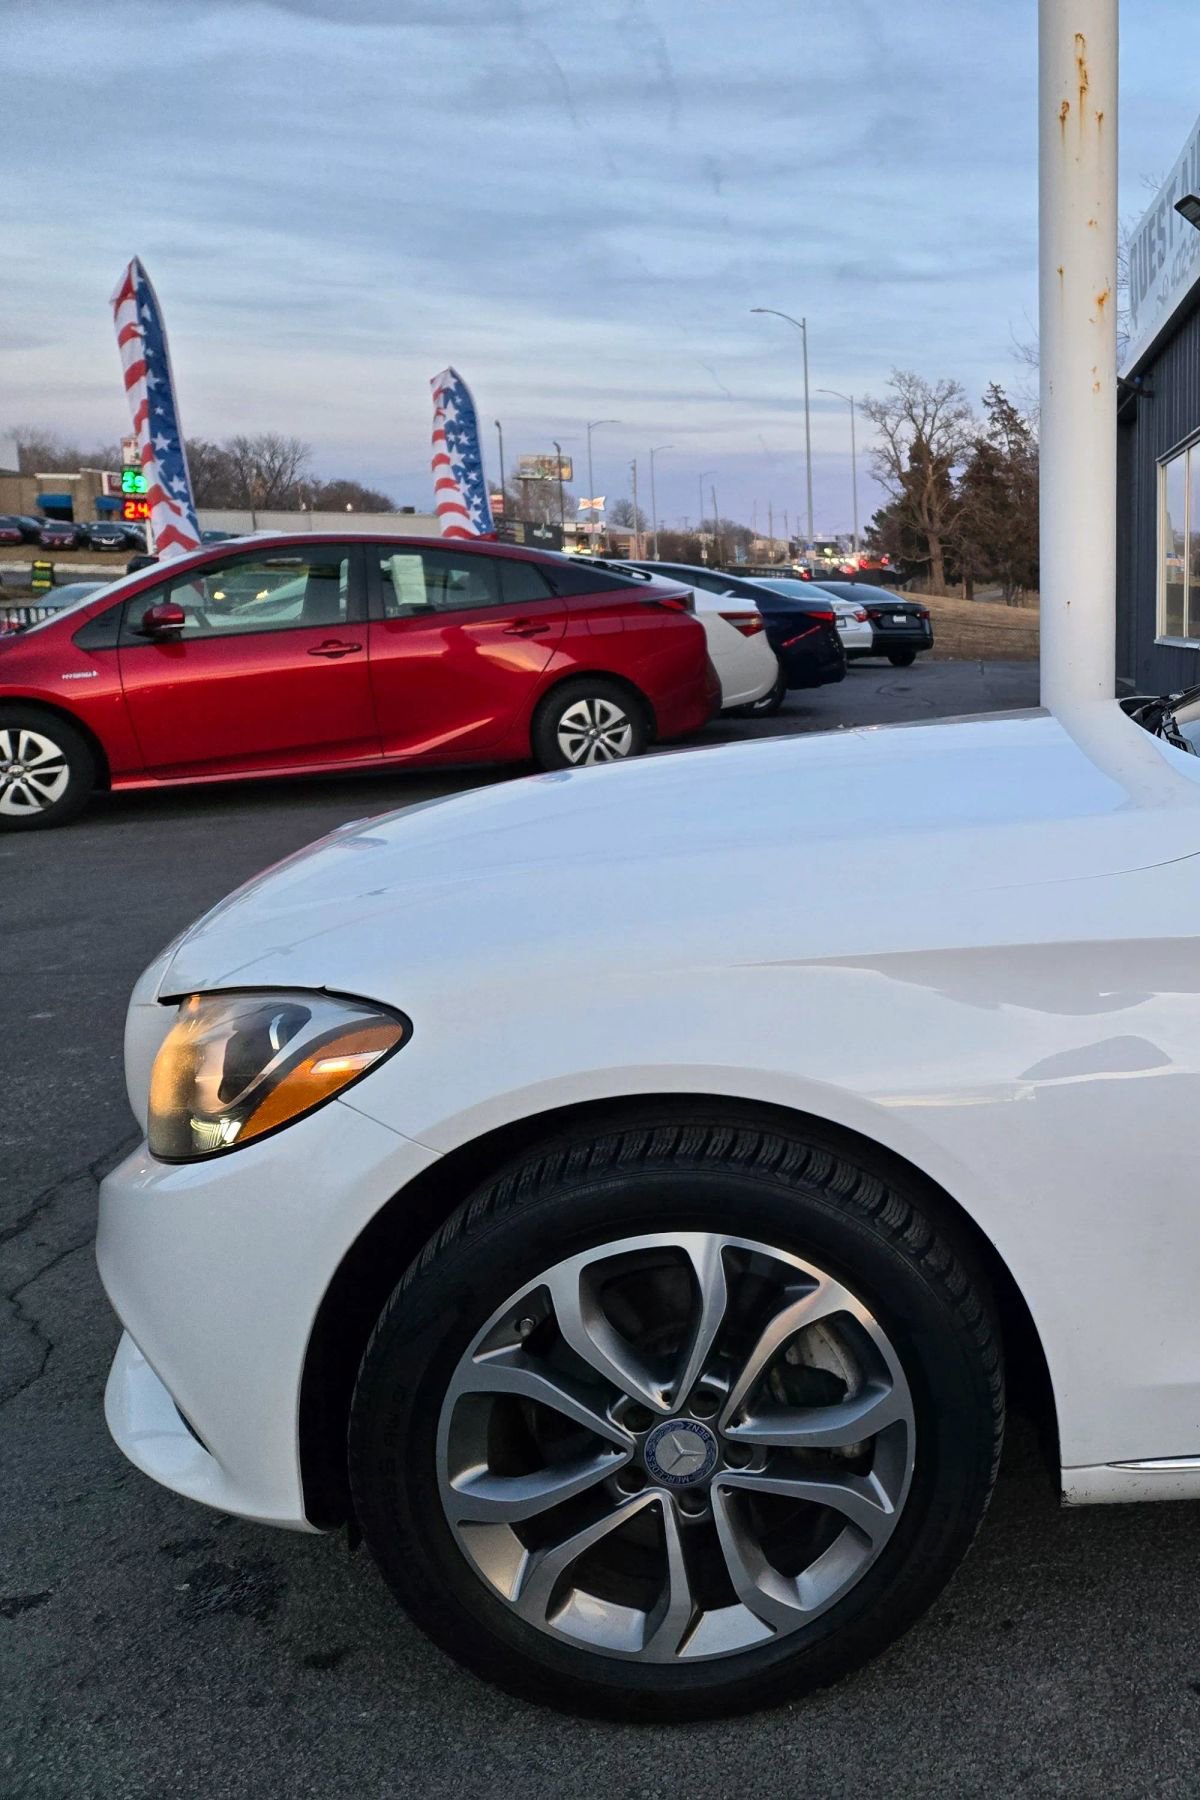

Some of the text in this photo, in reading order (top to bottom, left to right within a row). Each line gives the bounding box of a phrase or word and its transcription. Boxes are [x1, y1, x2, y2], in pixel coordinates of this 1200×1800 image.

[1129, 178, 1176, 330] QUEST
[122, 471, 147, 493] 2.9
[124, 501, 150, 519] 2.4
[647, 1422, 711, 1484] MERCEDES BENZ
